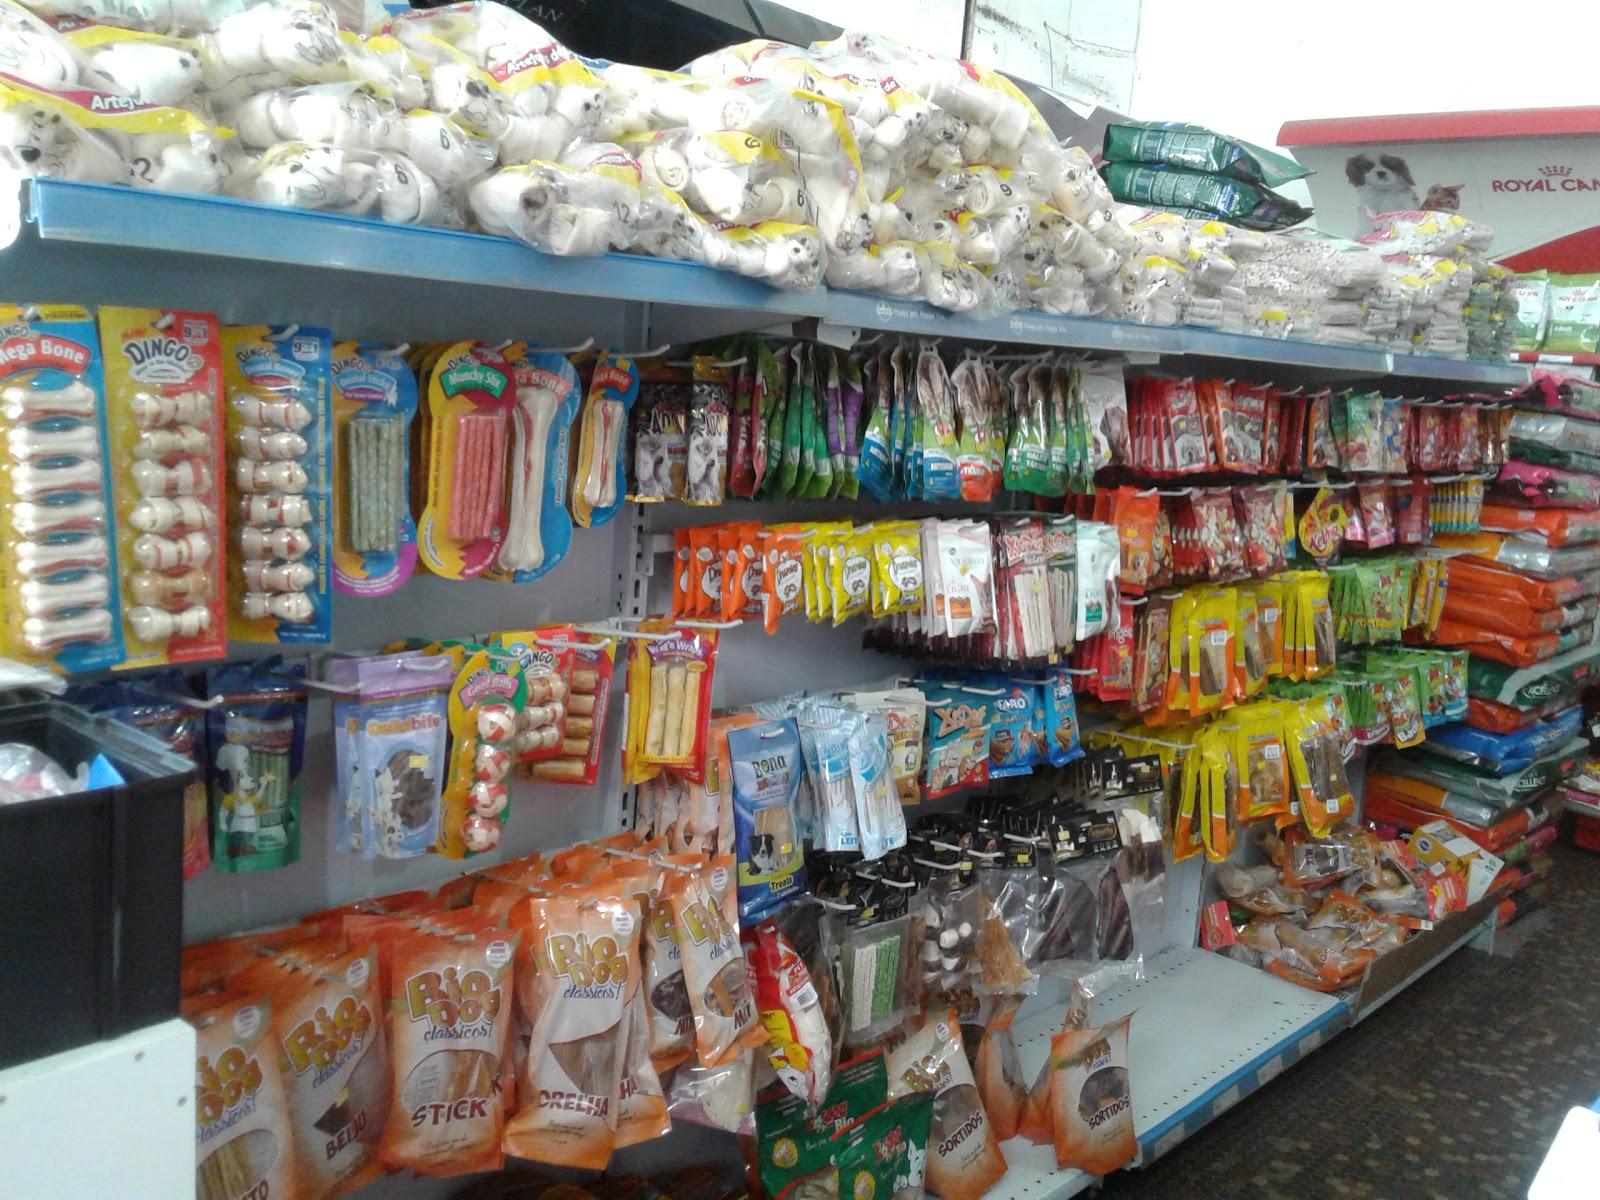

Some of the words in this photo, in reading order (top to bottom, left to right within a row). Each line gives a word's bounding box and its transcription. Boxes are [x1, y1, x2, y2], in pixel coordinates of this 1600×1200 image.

[440, 128, 451, 150] 6
[395, 163, 408, 185] 6
[1491, 179, 1556, 193] ROYAL
[40, 340, 85, 364] Bone
[124, 338, 190, 366] DINGO
[331, 358, 365, 376] DINGO
[531, 373, 566, 394] Bone
[527, 650, 554, 665] INGO
[996, 698, 1026, 711] FARO
[770, 875, 794, 892] Treats
[568, 955, 629, 988] Dog
[426, 988, 501, 1029] Dog
[733, 1004, 752, 1031] MIX
[411, 1098, 488, 1128] STICK
[538, 1088, 609, 1118] ORELHA
[1088, 1095, 1131, 1131] SORTIDOS
[325, 1110, 367, 1160] BEIJO
[937, 1111, 984, 1158] SORTIDOS
